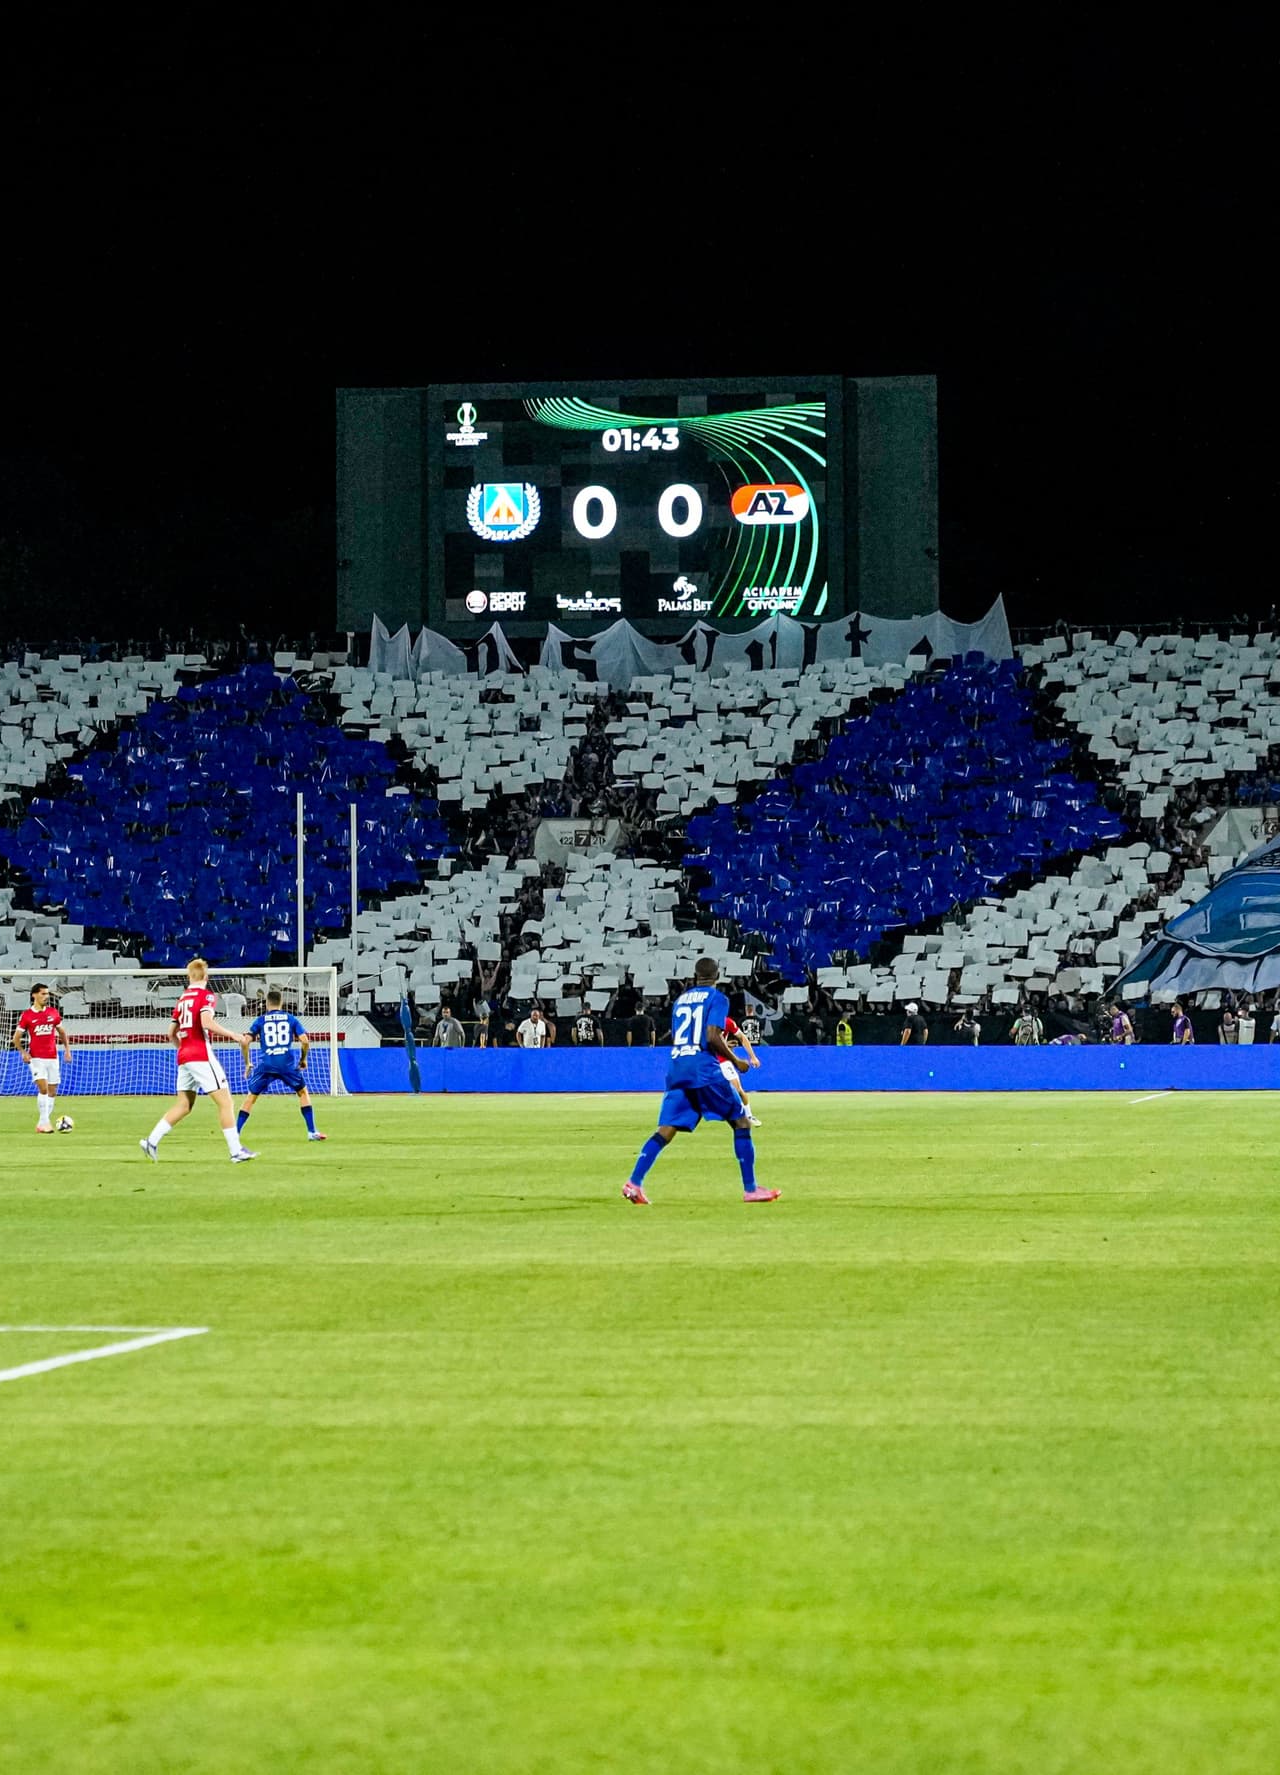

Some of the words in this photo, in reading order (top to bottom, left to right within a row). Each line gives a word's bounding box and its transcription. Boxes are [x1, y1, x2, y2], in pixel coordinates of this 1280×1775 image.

[601, 427, 680, 452] 01:43
[572, 485, 617, 539] 0
[658, 483, 703, 538] 0
[746, 490, 795, 517] AZ
[489, 591, 527, 601] SPORT
[489, 601, 526, 612] DEPOT
[578, 835, 587, 845] 7
[177, 998, 195, 1029] 26
[673, 1004, 704, 1046] 21
[263, 1020, 290, 1047] 88
